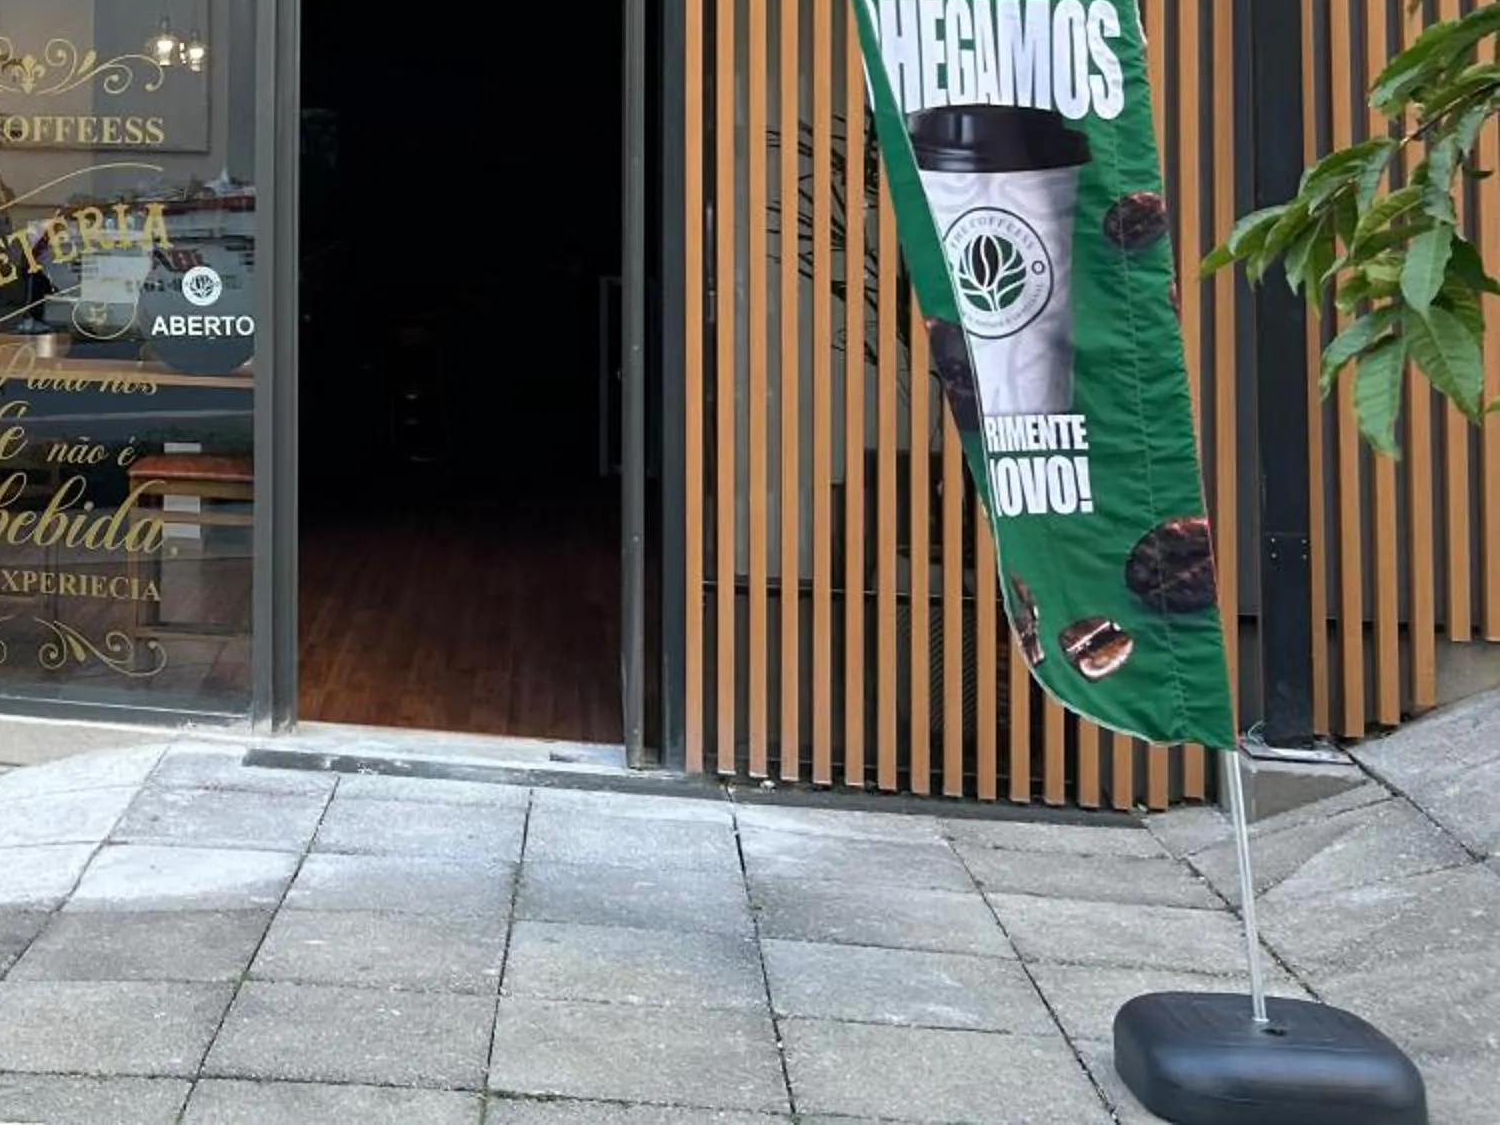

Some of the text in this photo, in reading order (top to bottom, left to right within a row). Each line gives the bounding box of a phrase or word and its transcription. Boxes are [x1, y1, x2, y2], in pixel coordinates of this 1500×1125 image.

[151, 315, 256, 337] ABERTO
[46, 436, 109, 466] não
[117, 436, 137, 467] é
